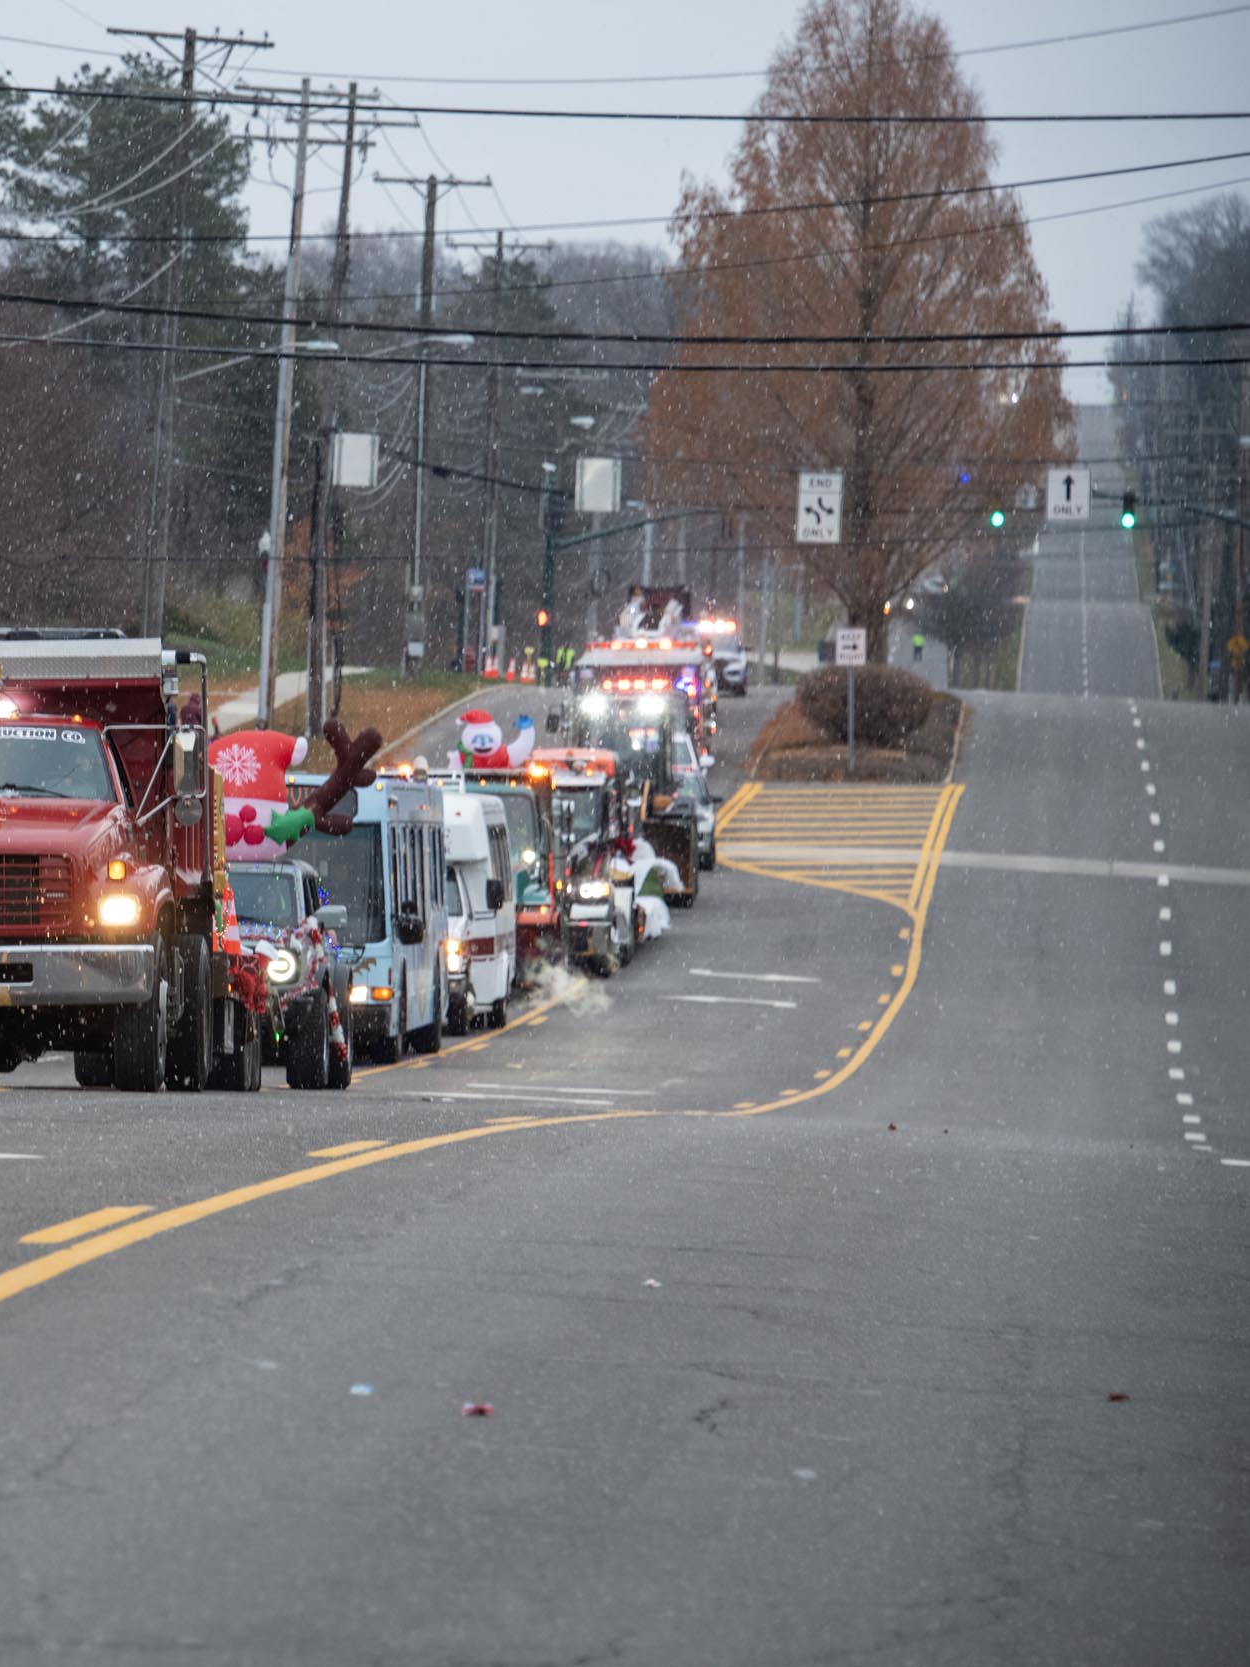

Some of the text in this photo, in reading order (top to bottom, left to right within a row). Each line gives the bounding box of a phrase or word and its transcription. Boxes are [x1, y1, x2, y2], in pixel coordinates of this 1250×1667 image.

[809, 478, 833, 489] END
[1053, 504, 1083, 515] ONLY
[801, 527, 835, 538] ONLY
[62, 731, 85, 744] CO.
